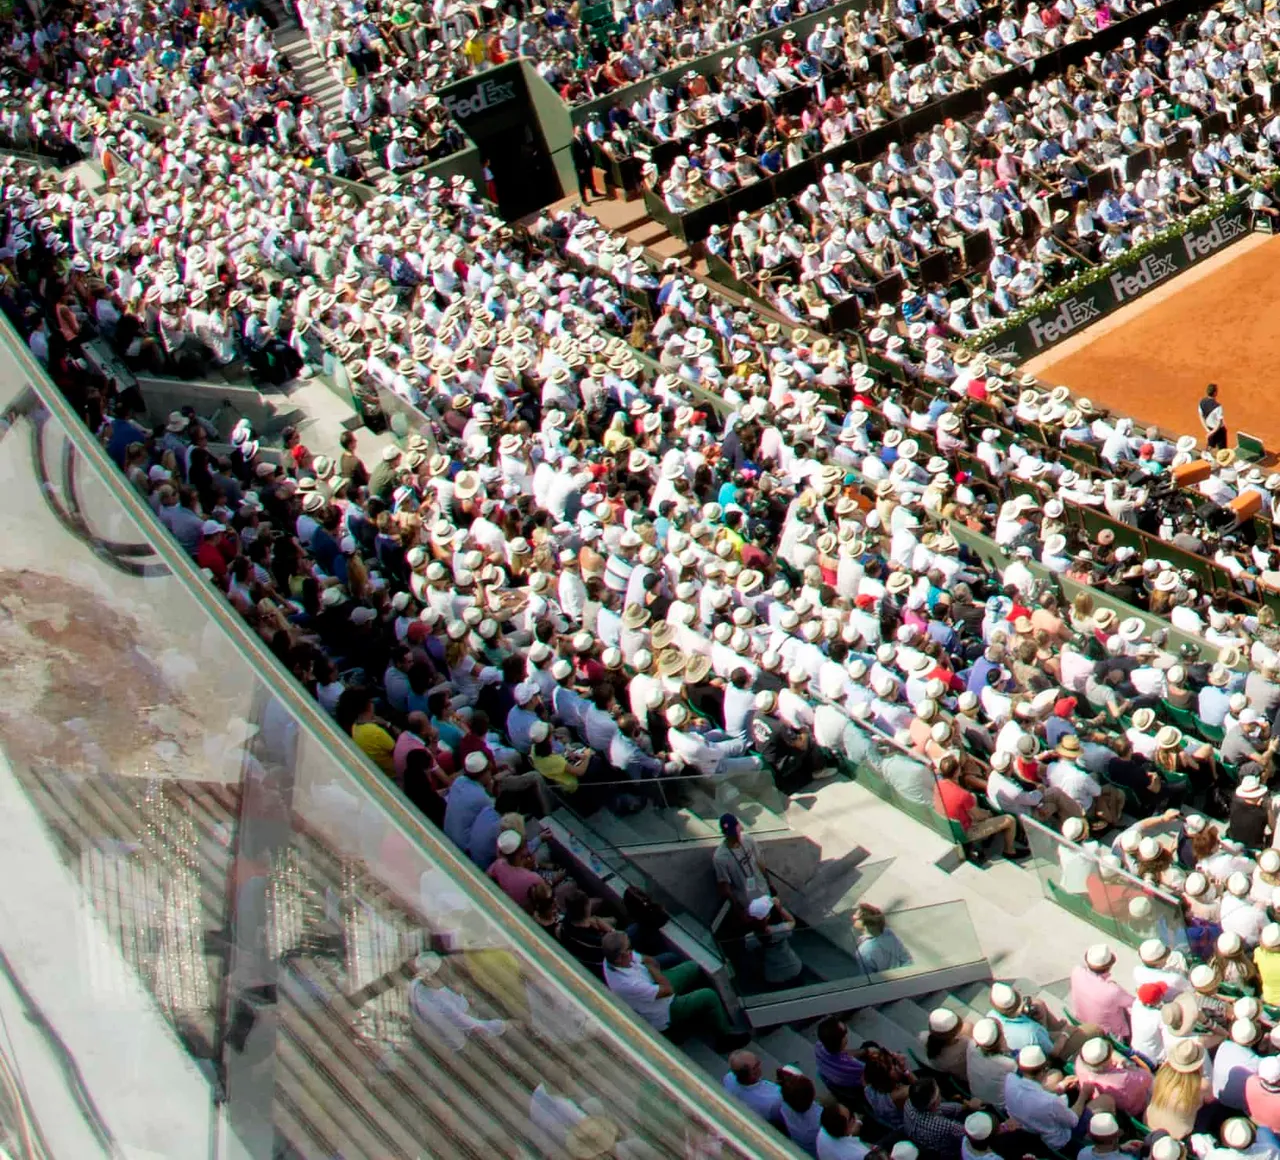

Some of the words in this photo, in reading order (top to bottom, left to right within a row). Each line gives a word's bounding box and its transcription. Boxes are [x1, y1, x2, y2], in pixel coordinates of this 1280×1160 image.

[443, 79, 516, 120] FedEx
[1182, 213, 1247, 261] FedEx
[1110, 251, 1178, 303] FedEx
[1028, 296, 1100, 348] FedEx
